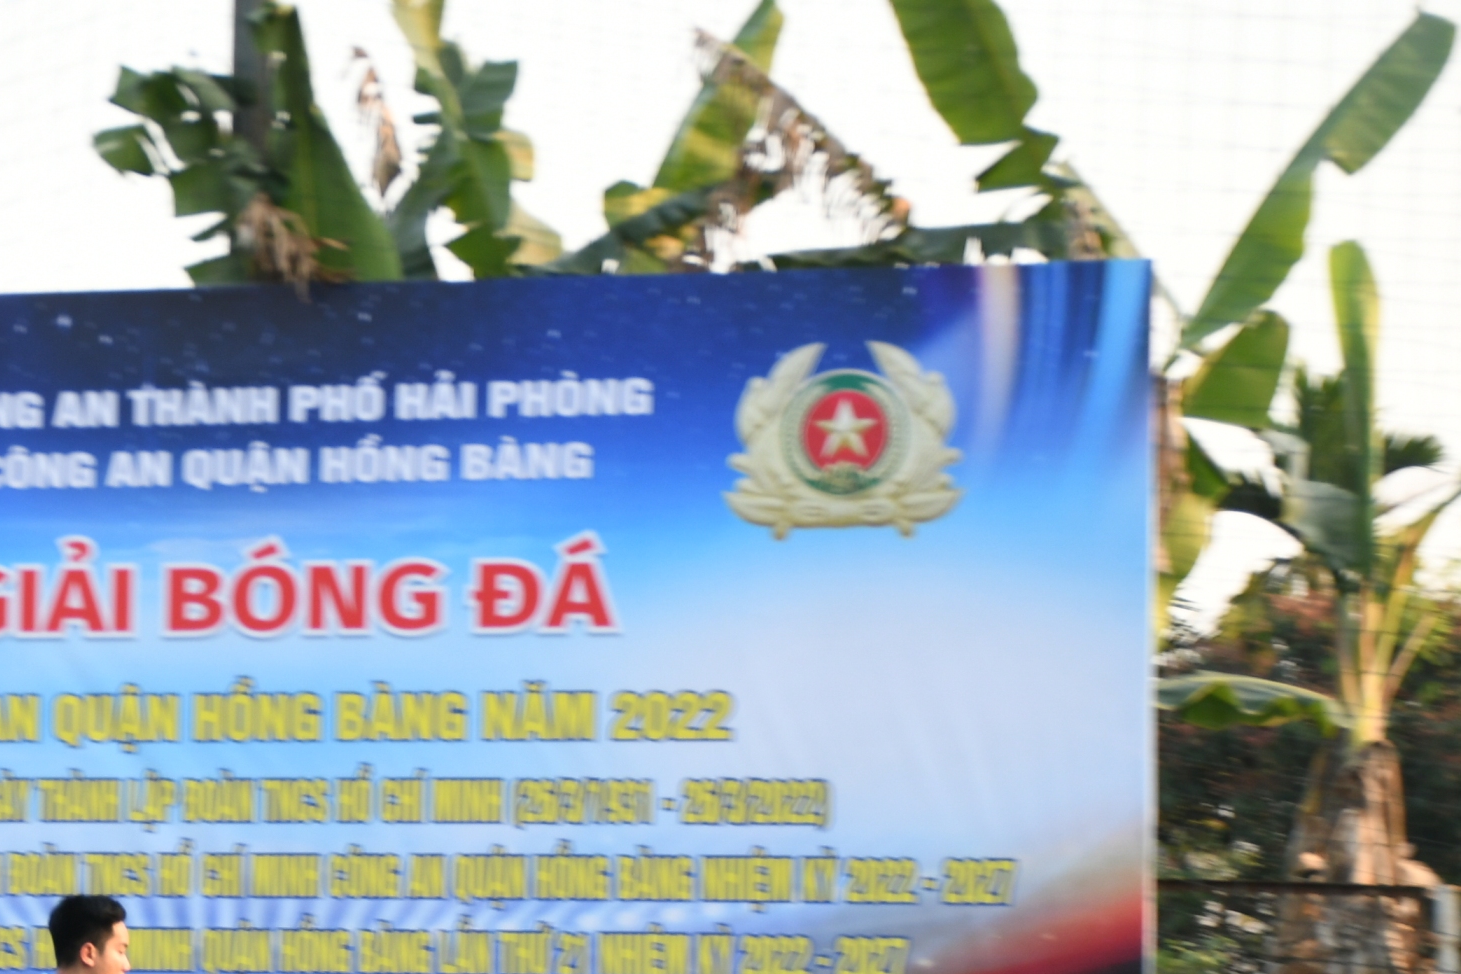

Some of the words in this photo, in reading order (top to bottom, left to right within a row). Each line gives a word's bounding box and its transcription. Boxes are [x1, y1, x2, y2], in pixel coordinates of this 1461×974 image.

[53, 391, 119, 428] AN
[126, 380, 279, 427] THÀNH
[288, 371, 386, 422] PHỐ
[394, 371, 477, 420] HẢI
[486, 370, 653, 419] PHÒNG
[105, 450, 173, 488] AN
[182, 441, 309, 492] QUẬN
[320, 434, 450, 483] HỒNG
[461, 436, 594, 481] BÀNG
[164, 536, 445, 635] BÓNG
[470, 531, 618, 634] ĐÁ
[54, 682, 181, 755] QUẬN
[191, 675, 321, 743] HỒNG
[333, 680, 467, 742] BÀNG
[481, 680, 597, 742] NĂM
[610, 689, 735, 742] 2022
[844, 856, 918, 905] 2022
[941, 857, 1017, 906] 2027
